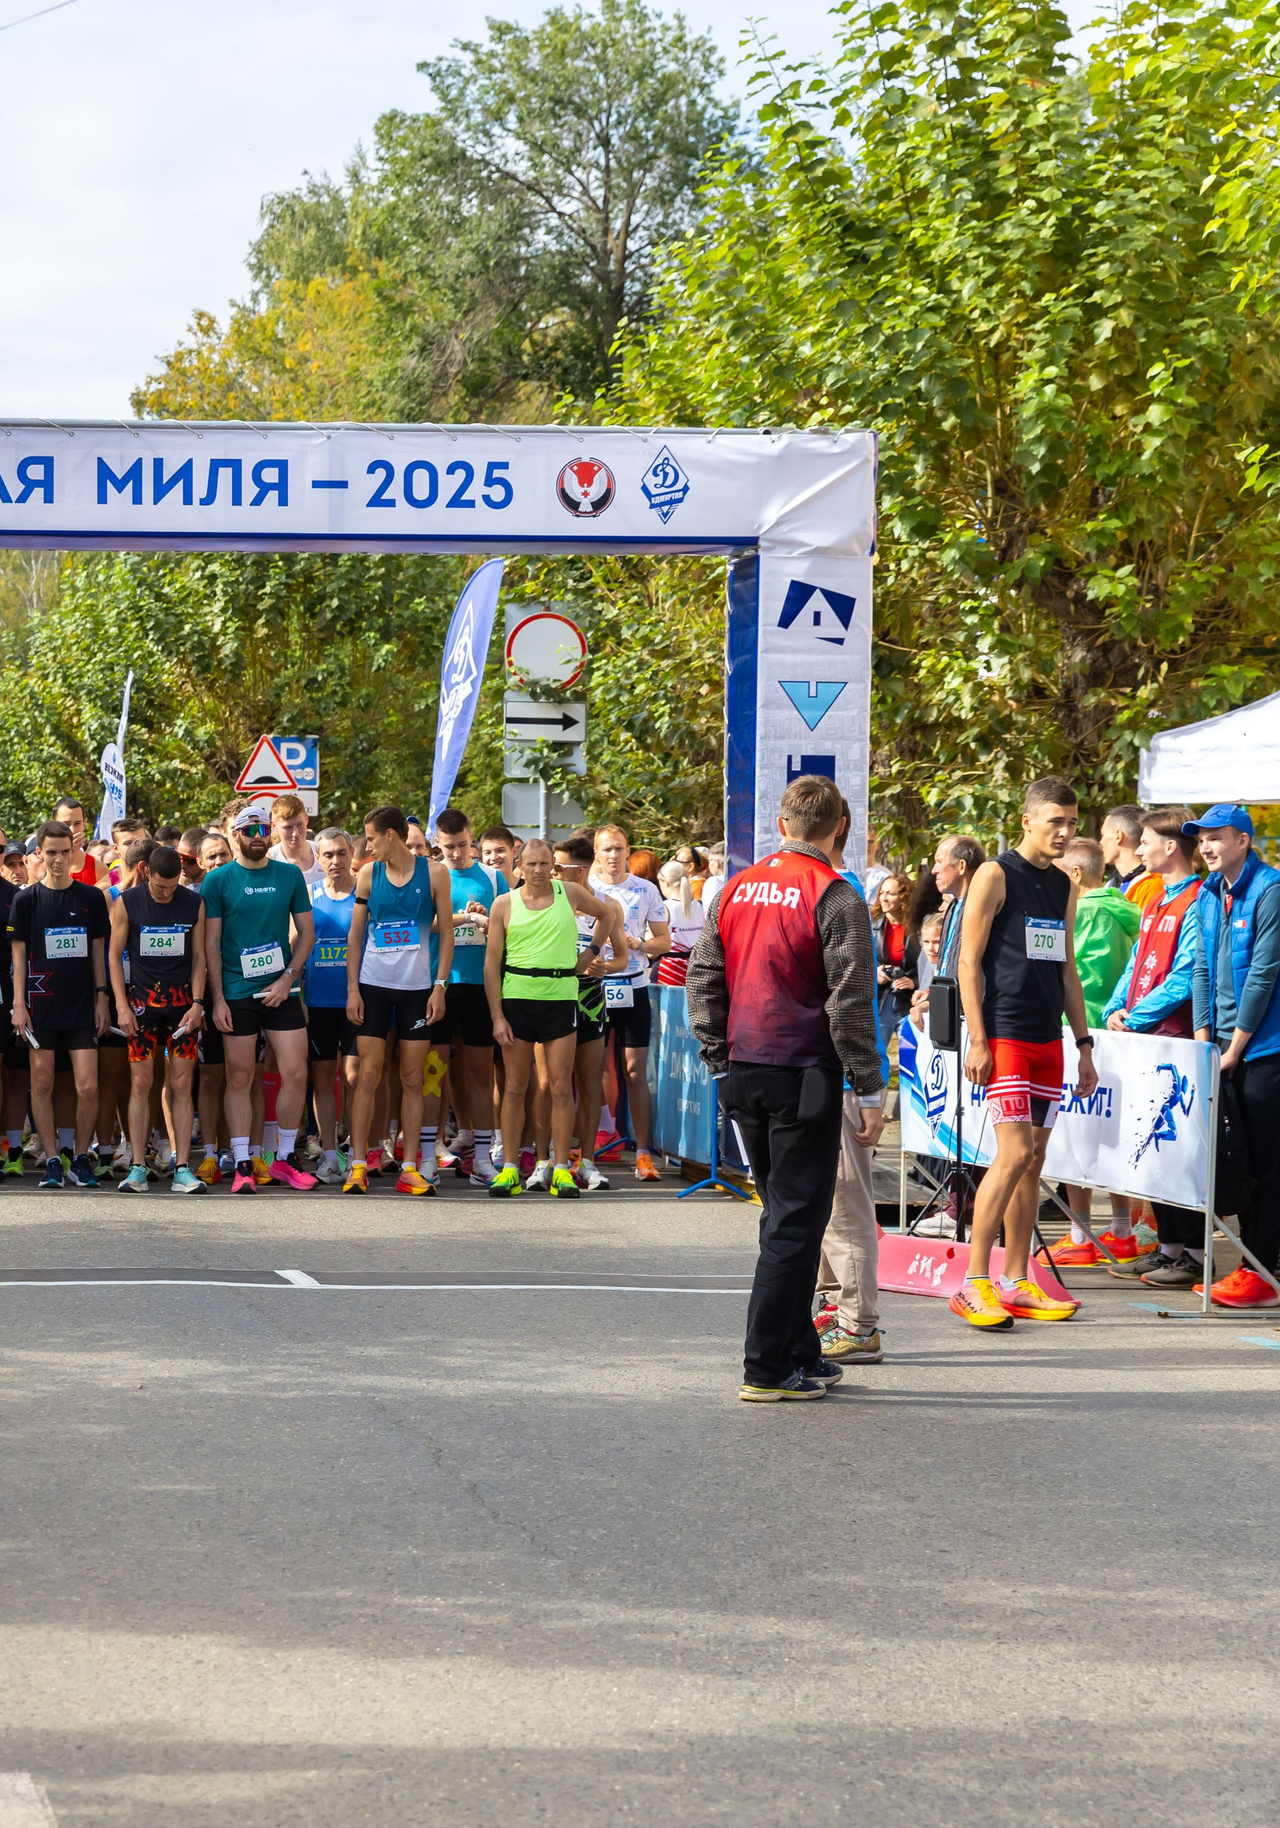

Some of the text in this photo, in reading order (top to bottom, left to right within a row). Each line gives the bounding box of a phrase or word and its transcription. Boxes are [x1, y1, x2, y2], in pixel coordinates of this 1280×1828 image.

[96, 456, 290, 507] МИЛЯ
[365, 459, 515, 510] 2025
[651, 490, 684, 505] УДМУРТИЯ
[732, 881, 801, 910] СУДЬЯ
[384, 930, 410, 944] 532
[320, 946, 348, 960] 1172
[606, 988, 625, 1000] 56
[1059, 1083, 1113, 1119] ЕЖИТ!
